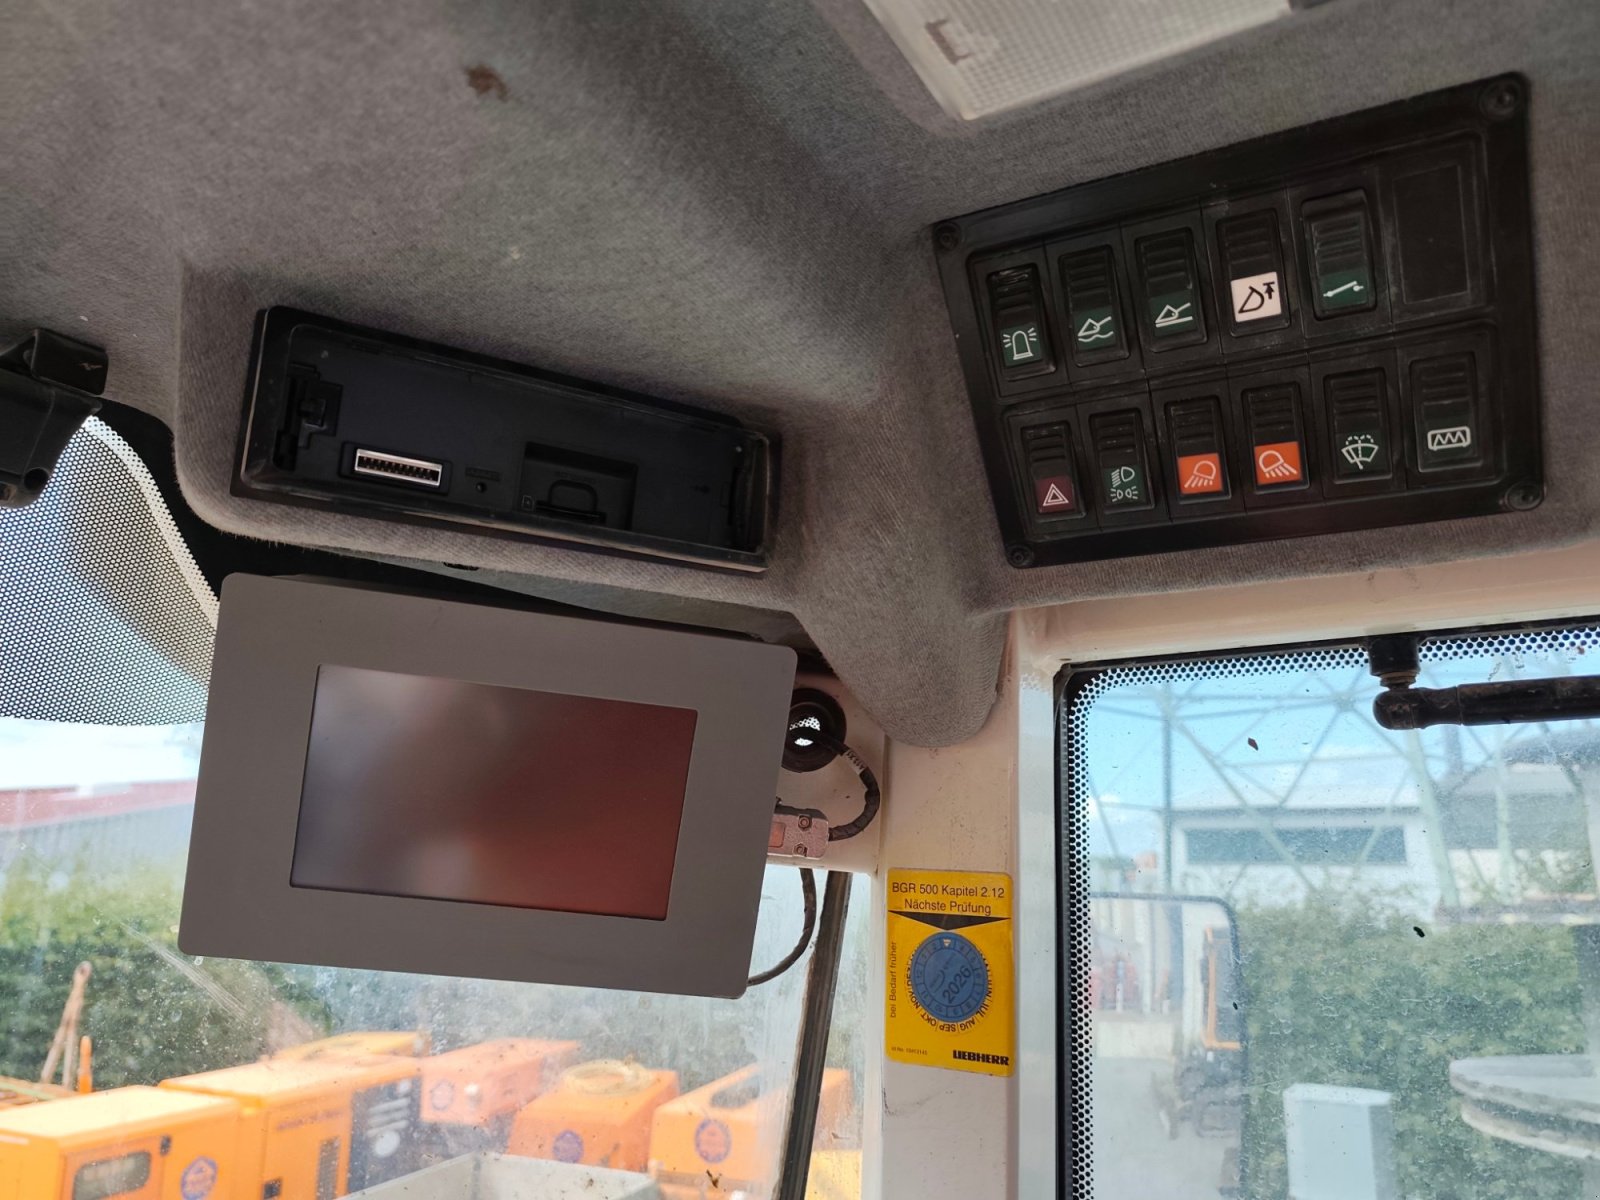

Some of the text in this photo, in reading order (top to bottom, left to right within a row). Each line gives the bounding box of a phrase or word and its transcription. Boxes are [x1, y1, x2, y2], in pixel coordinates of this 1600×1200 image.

[892, 882, 1005, 898] BGR 500 Kapitel 2.12
[904, 899, 991, 916] Nächste Prüfung
[889, 941, 897, 968] früher
[942, 966, 972, 1004] 2026
[908, 990, 921, 1009] NOV
[975, 1003, 990, 1018] JUL
[921, 1012, 937, 1027] OKT
[940, 1023, 956, 1032] SEP
[959, 1017, 976, 1031] AUG
[953, 1050, 1009, 1066] LIEBHERR
